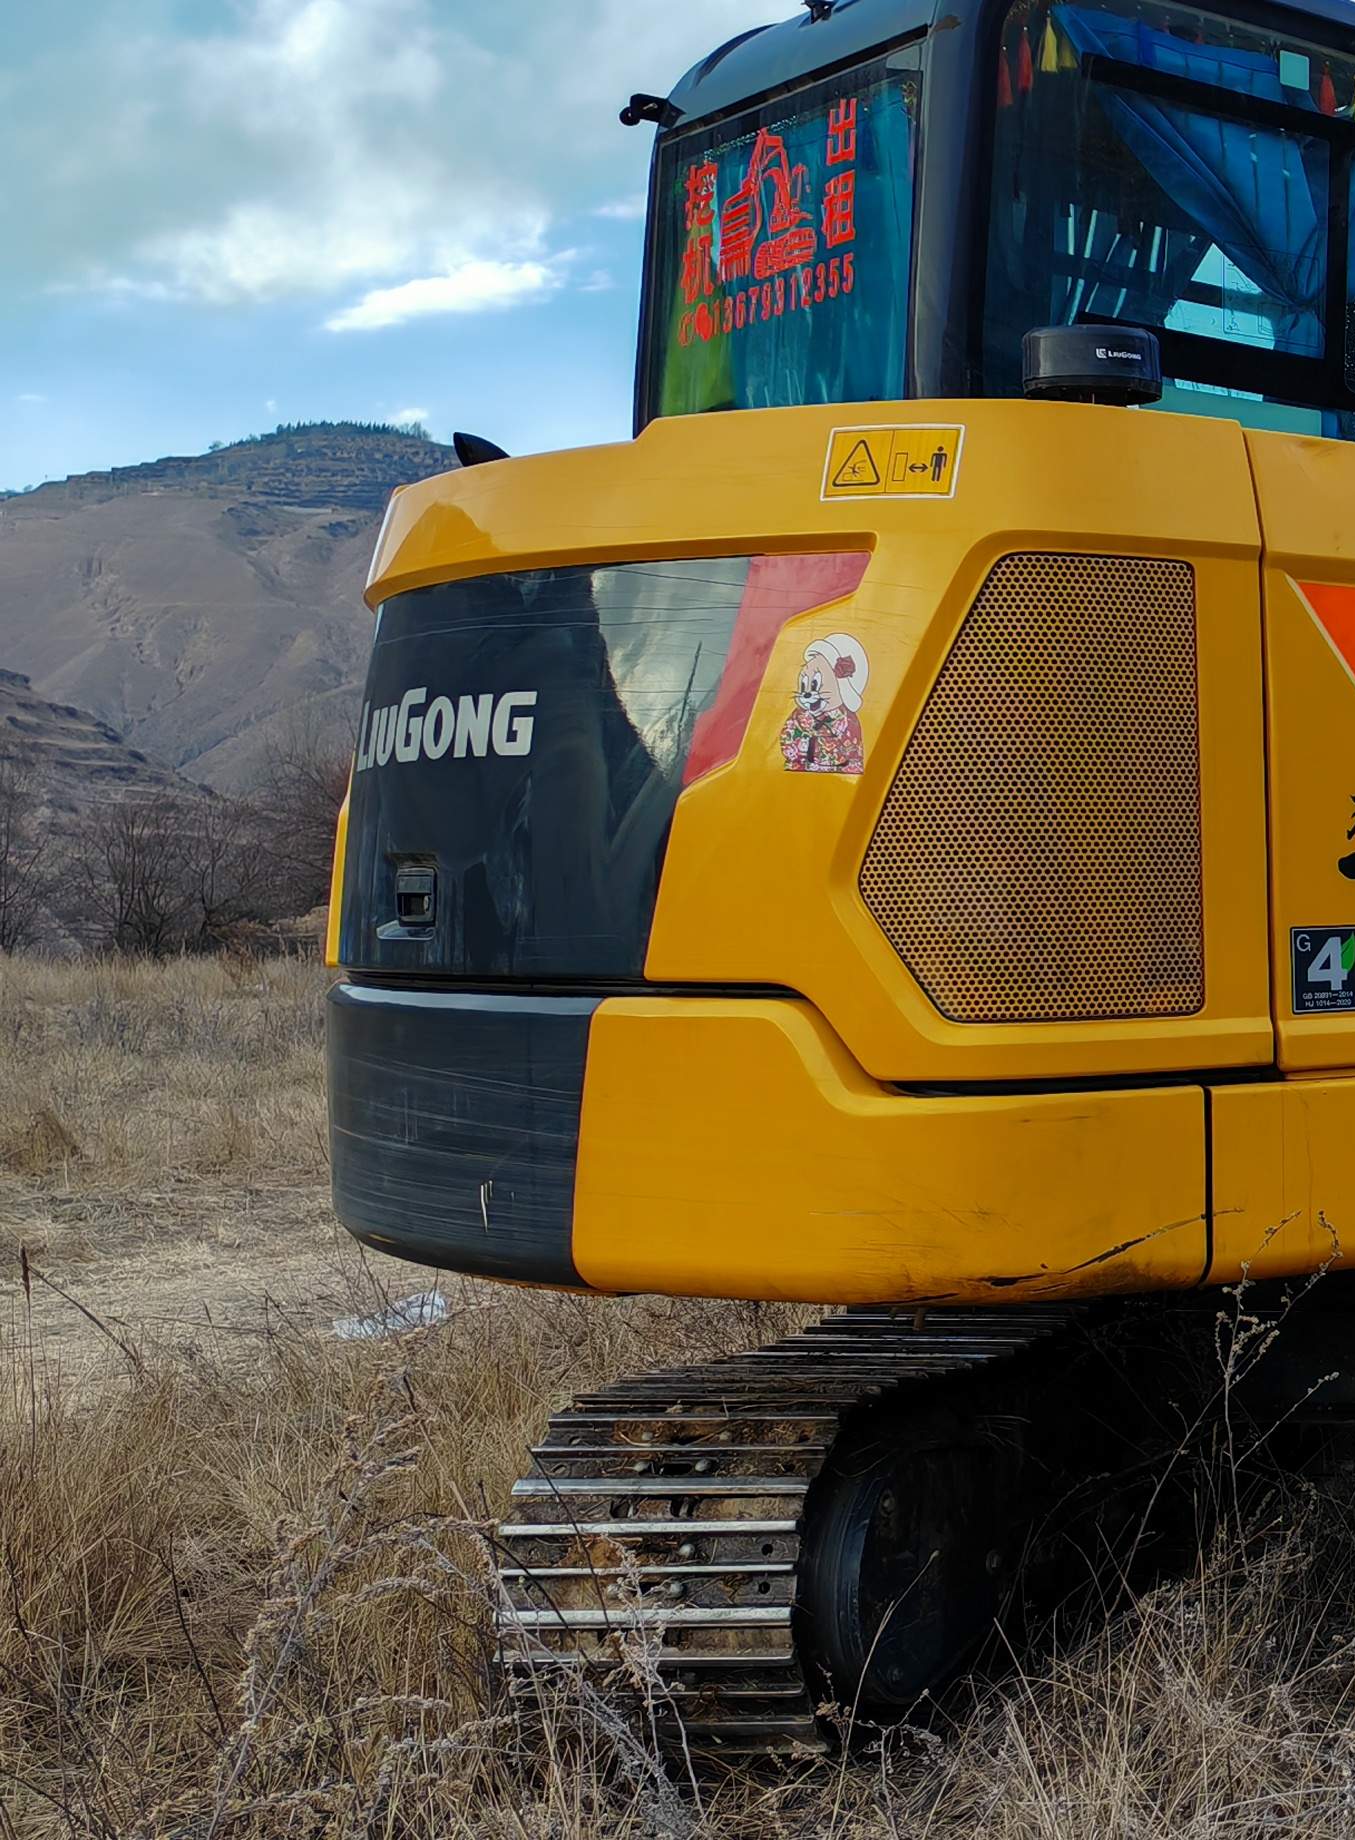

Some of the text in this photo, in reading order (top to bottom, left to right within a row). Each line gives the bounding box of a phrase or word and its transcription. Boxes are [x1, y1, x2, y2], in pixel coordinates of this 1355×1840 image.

[821, 97, 857, 249] 出租
[678, 161, 718, 305] 挖机
[1296, 934, 1311, 952] G
[1307, 936, 1347, 990] 4
